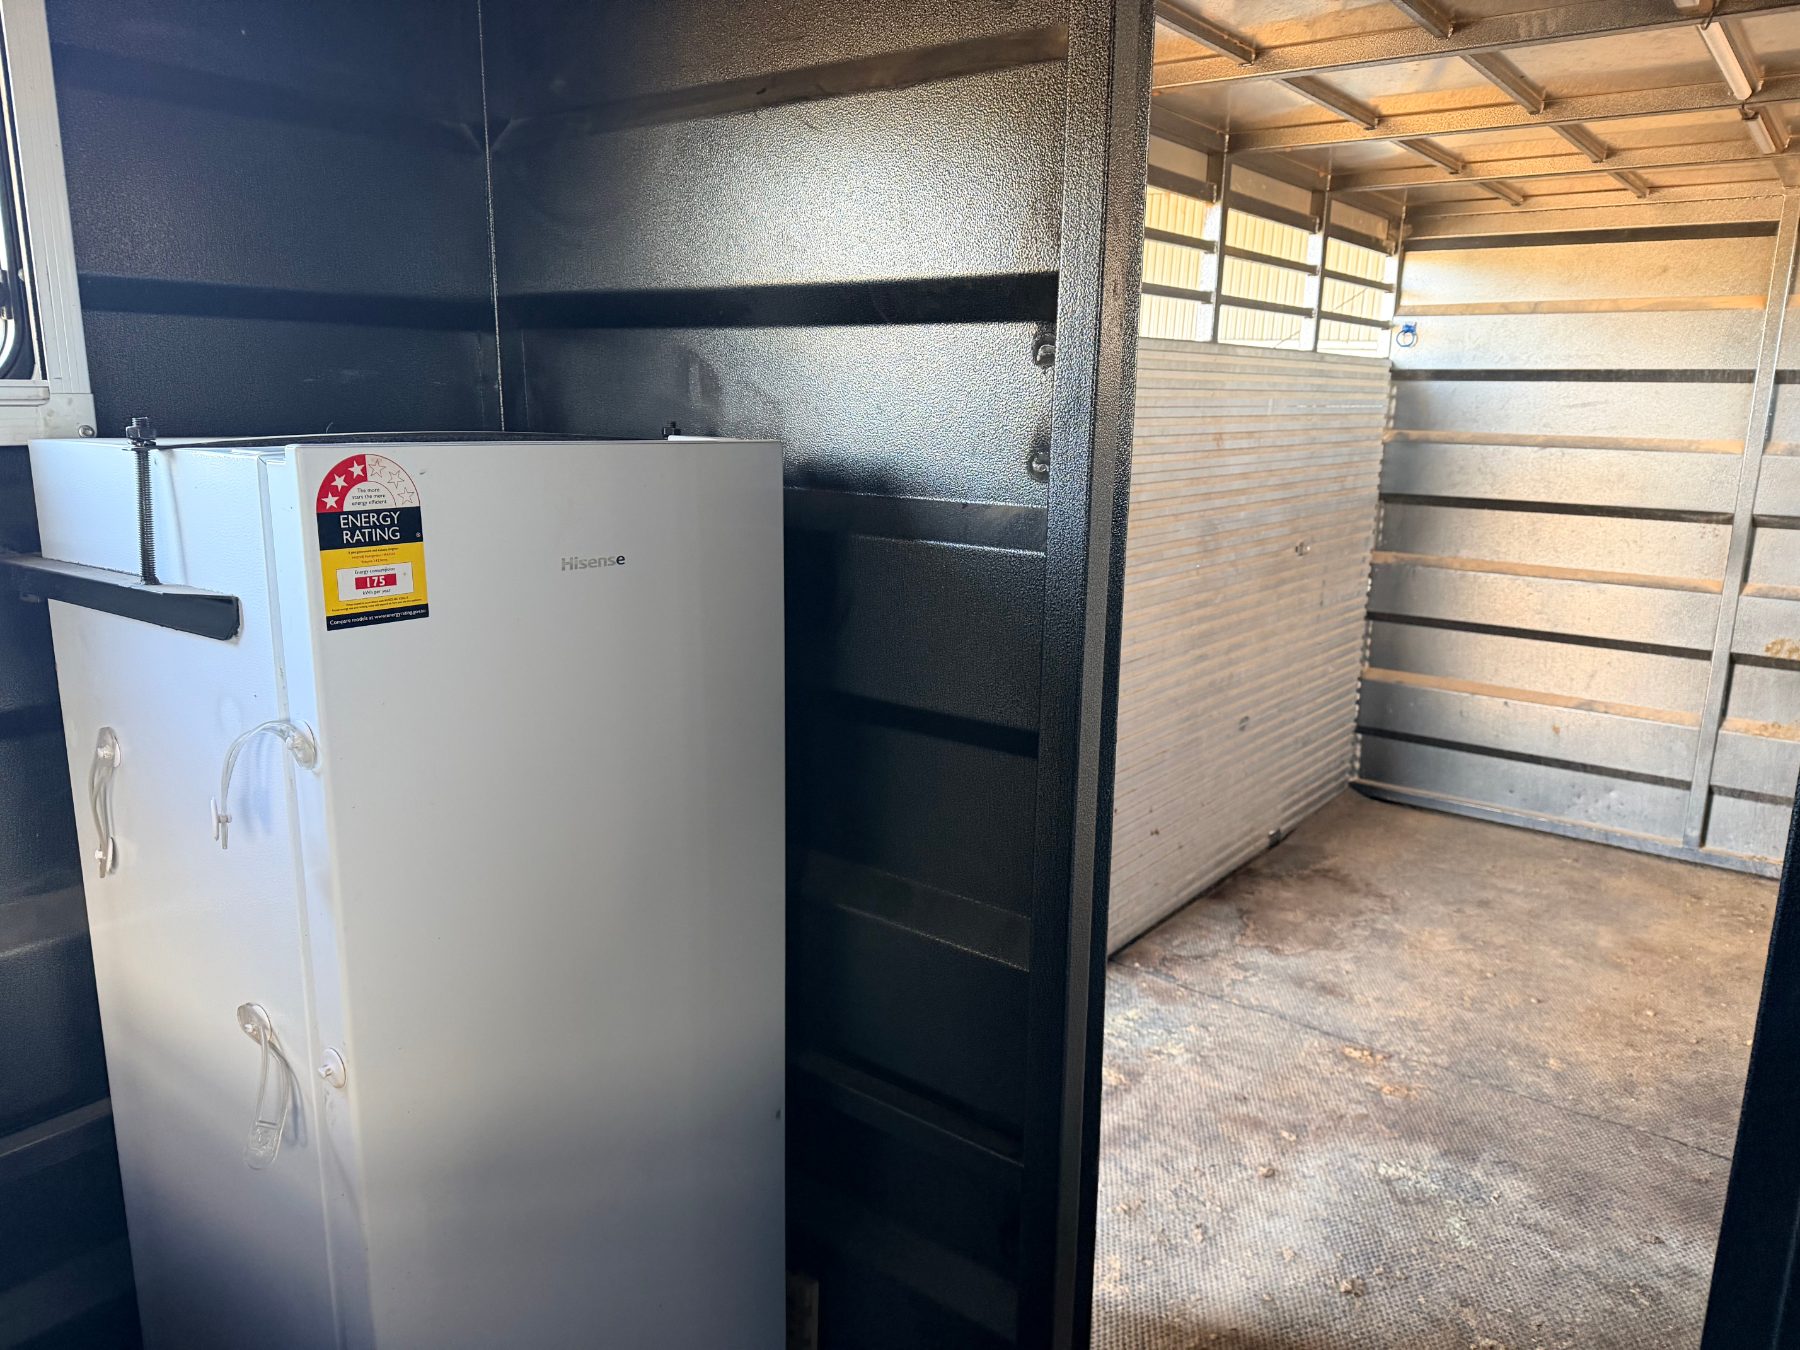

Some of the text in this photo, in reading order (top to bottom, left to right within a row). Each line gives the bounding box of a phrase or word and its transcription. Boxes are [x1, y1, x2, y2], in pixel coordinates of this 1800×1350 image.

[340, 511, 400, 528] ENERGY
[343, 527, 401, 544] RATING
[561, 555, 626, 572] Hisense
[366, 576, 386, 588] 175
[329, 618, 352, 626] Compare
